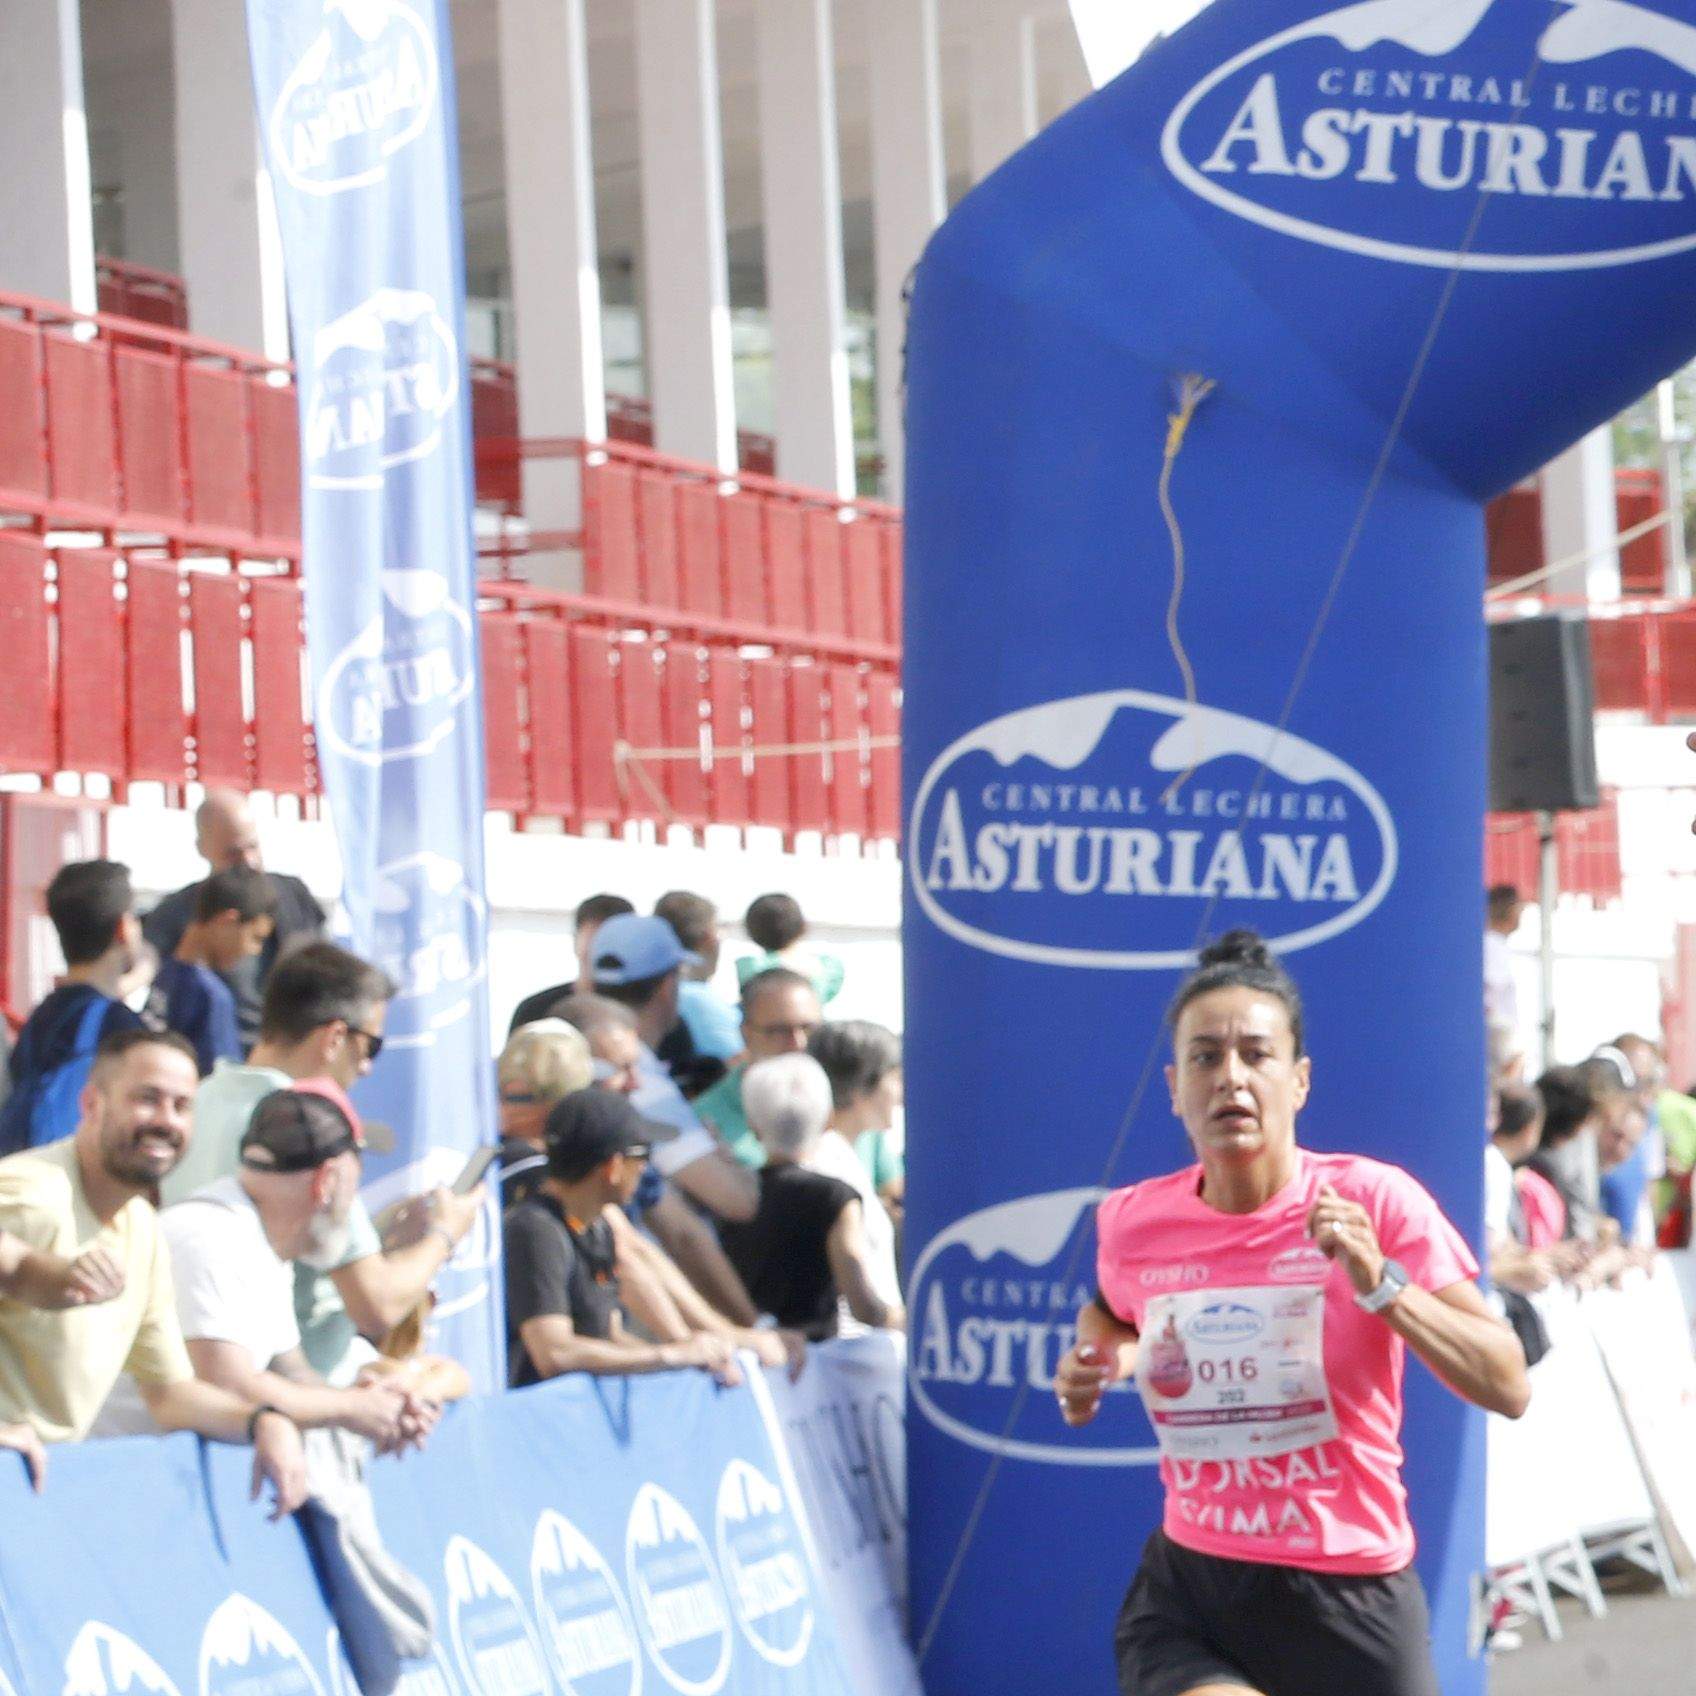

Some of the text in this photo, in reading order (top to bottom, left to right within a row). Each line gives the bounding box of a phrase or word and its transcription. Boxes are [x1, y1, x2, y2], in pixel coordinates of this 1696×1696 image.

[1319, 67, 1531, 108] CENTRAL
[982, 782, 1348, 822] CENTRAL LECHERA
[927, 788, 1359, 901] ASTURIANA
[960, 1277, 1095, 1310] CENTRA
[1198, 1357, 1259, 1384] 016
